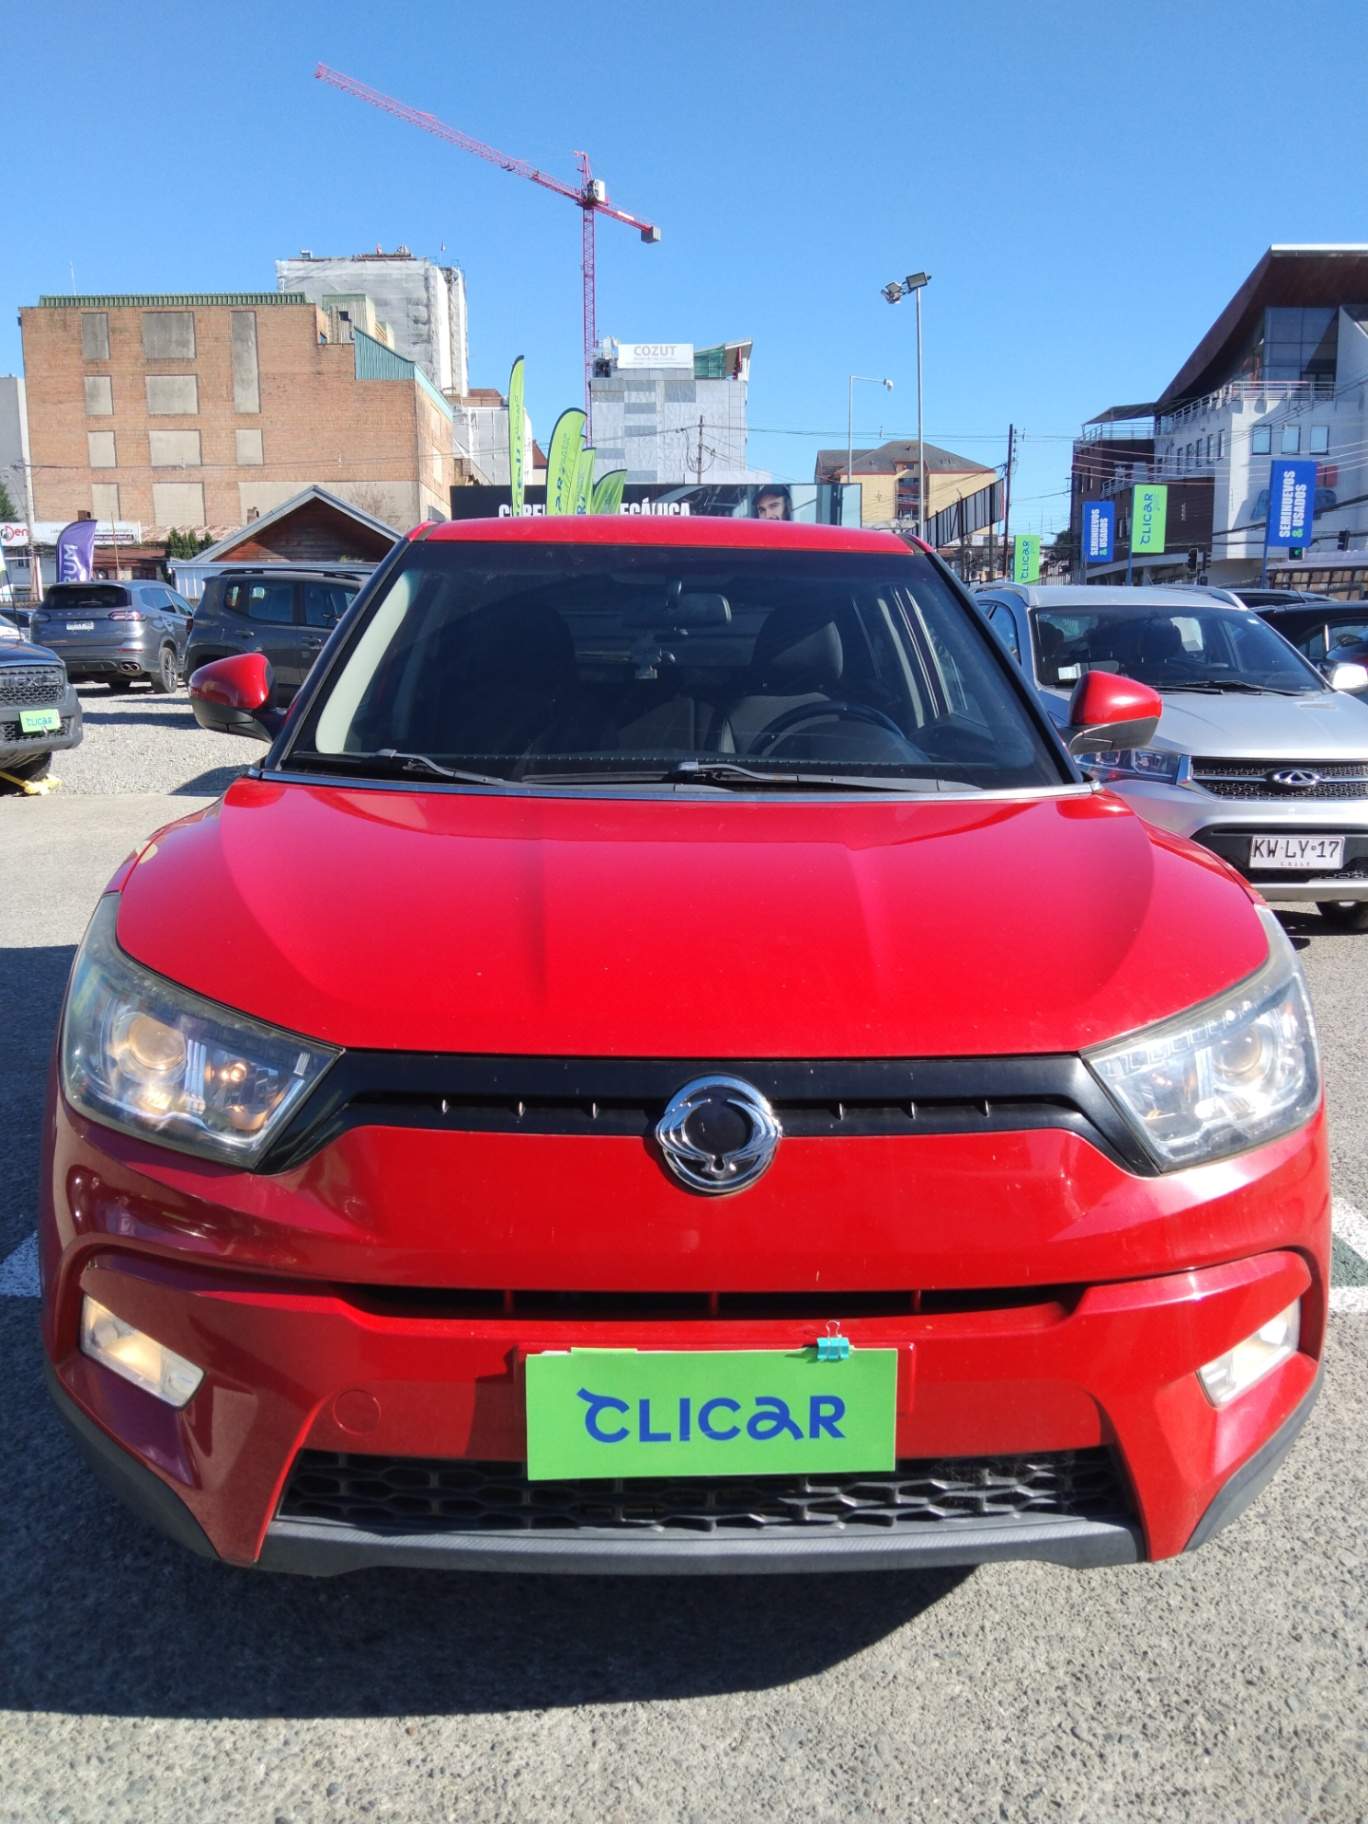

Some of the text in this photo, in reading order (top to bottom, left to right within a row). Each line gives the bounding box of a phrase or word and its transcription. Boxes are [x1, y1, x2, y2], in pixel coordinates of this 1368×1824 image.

[633, 345, 677, 356] COZUT
[1279, 470, 1296, 538] SEMINUEVOS
[1292, 484, 1307, 527] USADOS
[1090, 508, 1100, 556] SEMINUEVOS
[1099, 517, 1108, 547] USADOS
